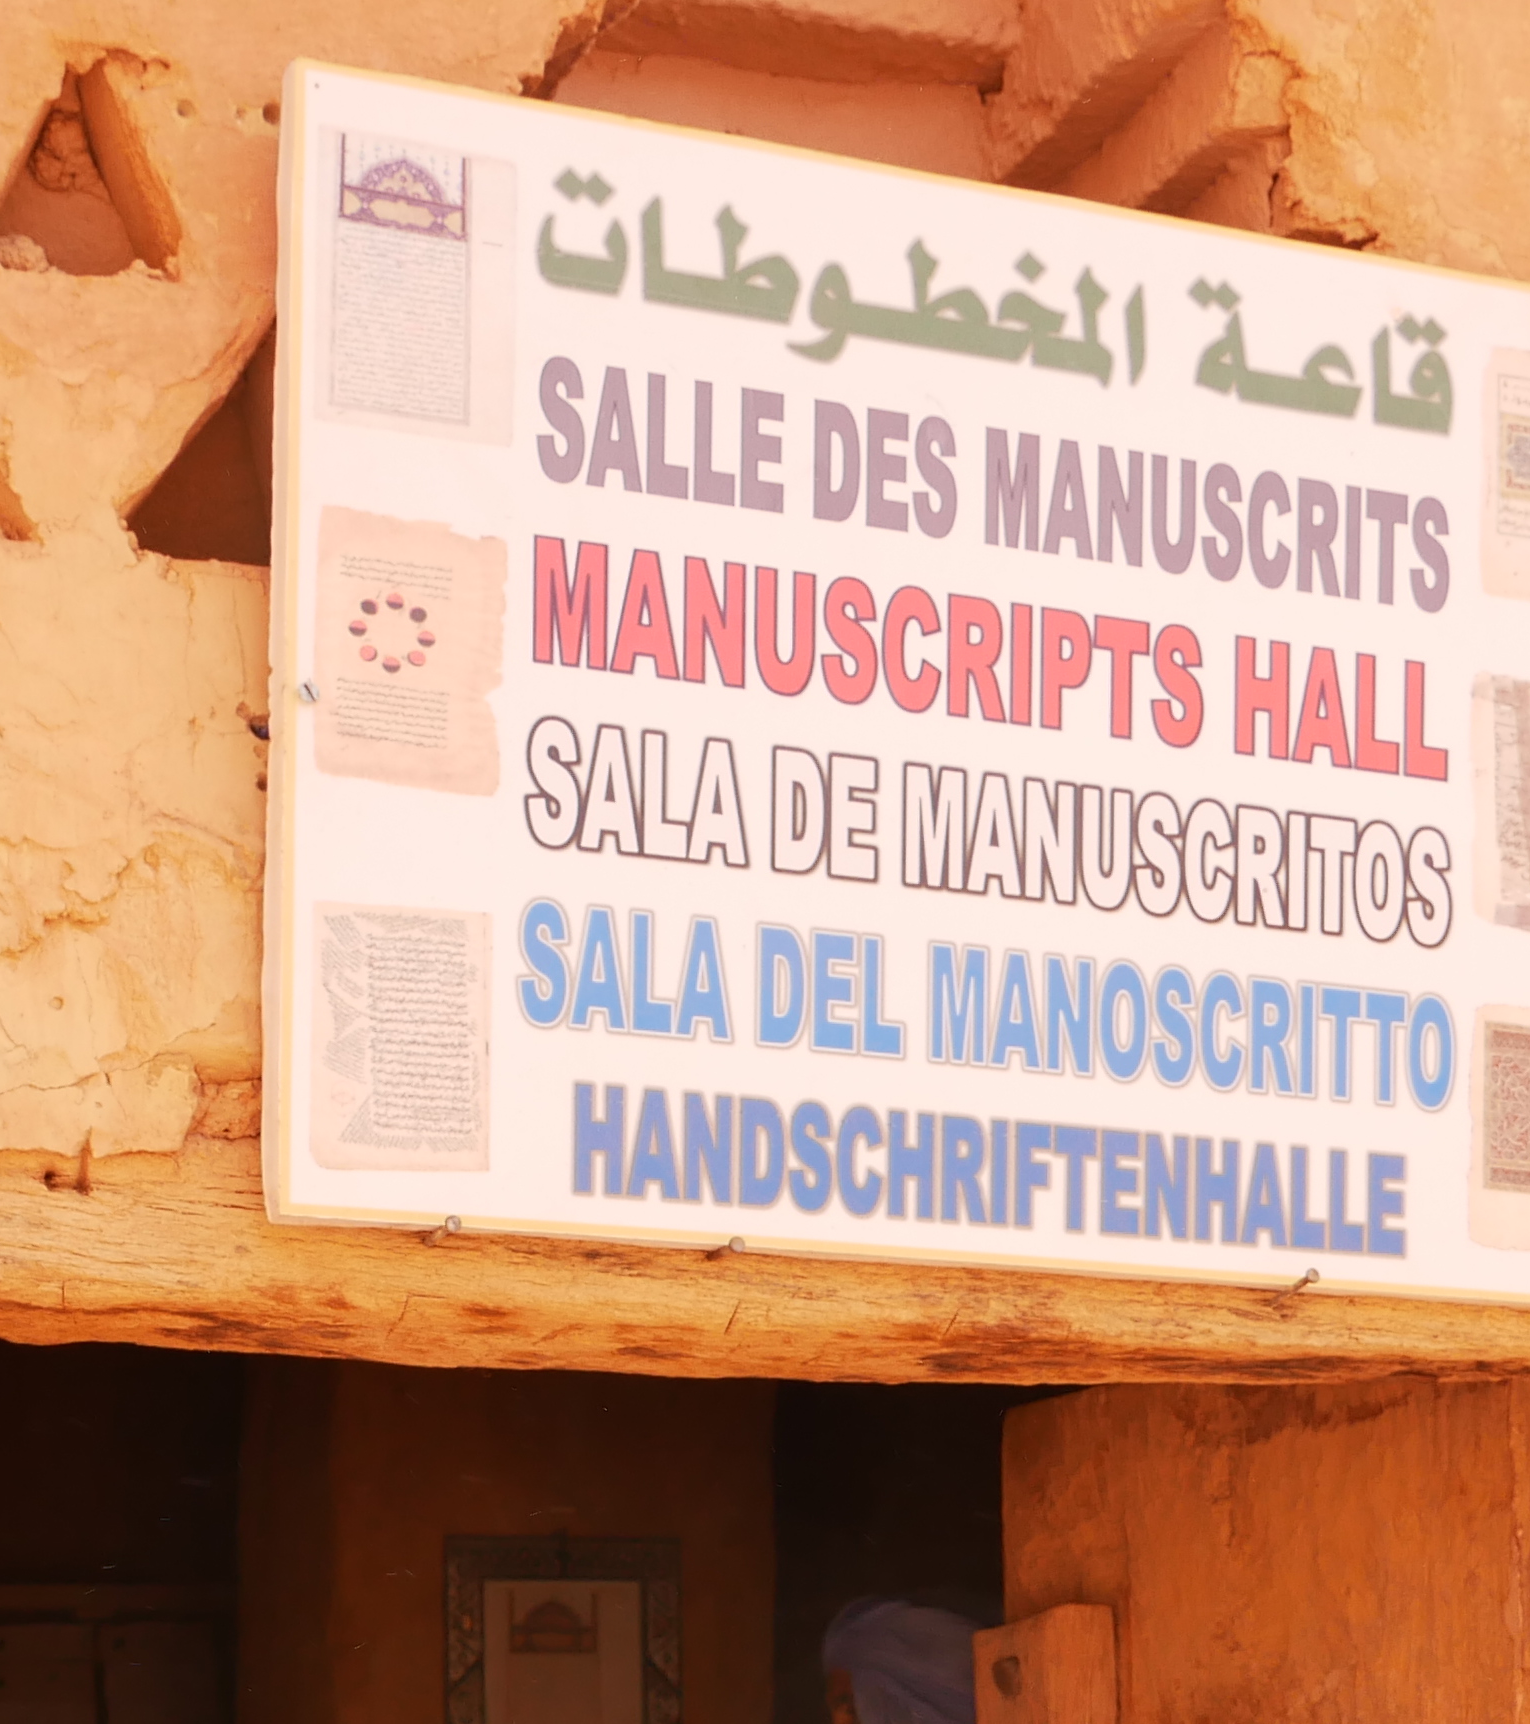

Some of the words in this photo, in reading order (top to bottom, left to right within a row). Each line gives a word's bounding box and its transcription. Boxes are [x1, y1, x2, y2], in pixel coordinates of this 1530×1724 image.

[536, 167, 1145, 386] المخطوطات
[1186, 276, 1454, 436] قاعة
[536, 355, 785, 514] SALLE
[813, 399, 957, 539] DES
[984, 426, 1450, 613] MANUSCRITS
[532, 534, 1204, 749] MANUSCRIPTS
[1233, 634, 1449, 781] HALL
[525, 715, 749, 868] SALA
[771, 744, 878, 882] DE
[902, 762, 1453, 948] MANUSCRITOS
[516, 897, 733, 1043] SALA
[755, 922, 905, 1059] DEL
[928, 939, 1456, 1112] MANOSCRITTO
[572, 1080, 1408, 1258] HANDSCHRIFTENHALLE
